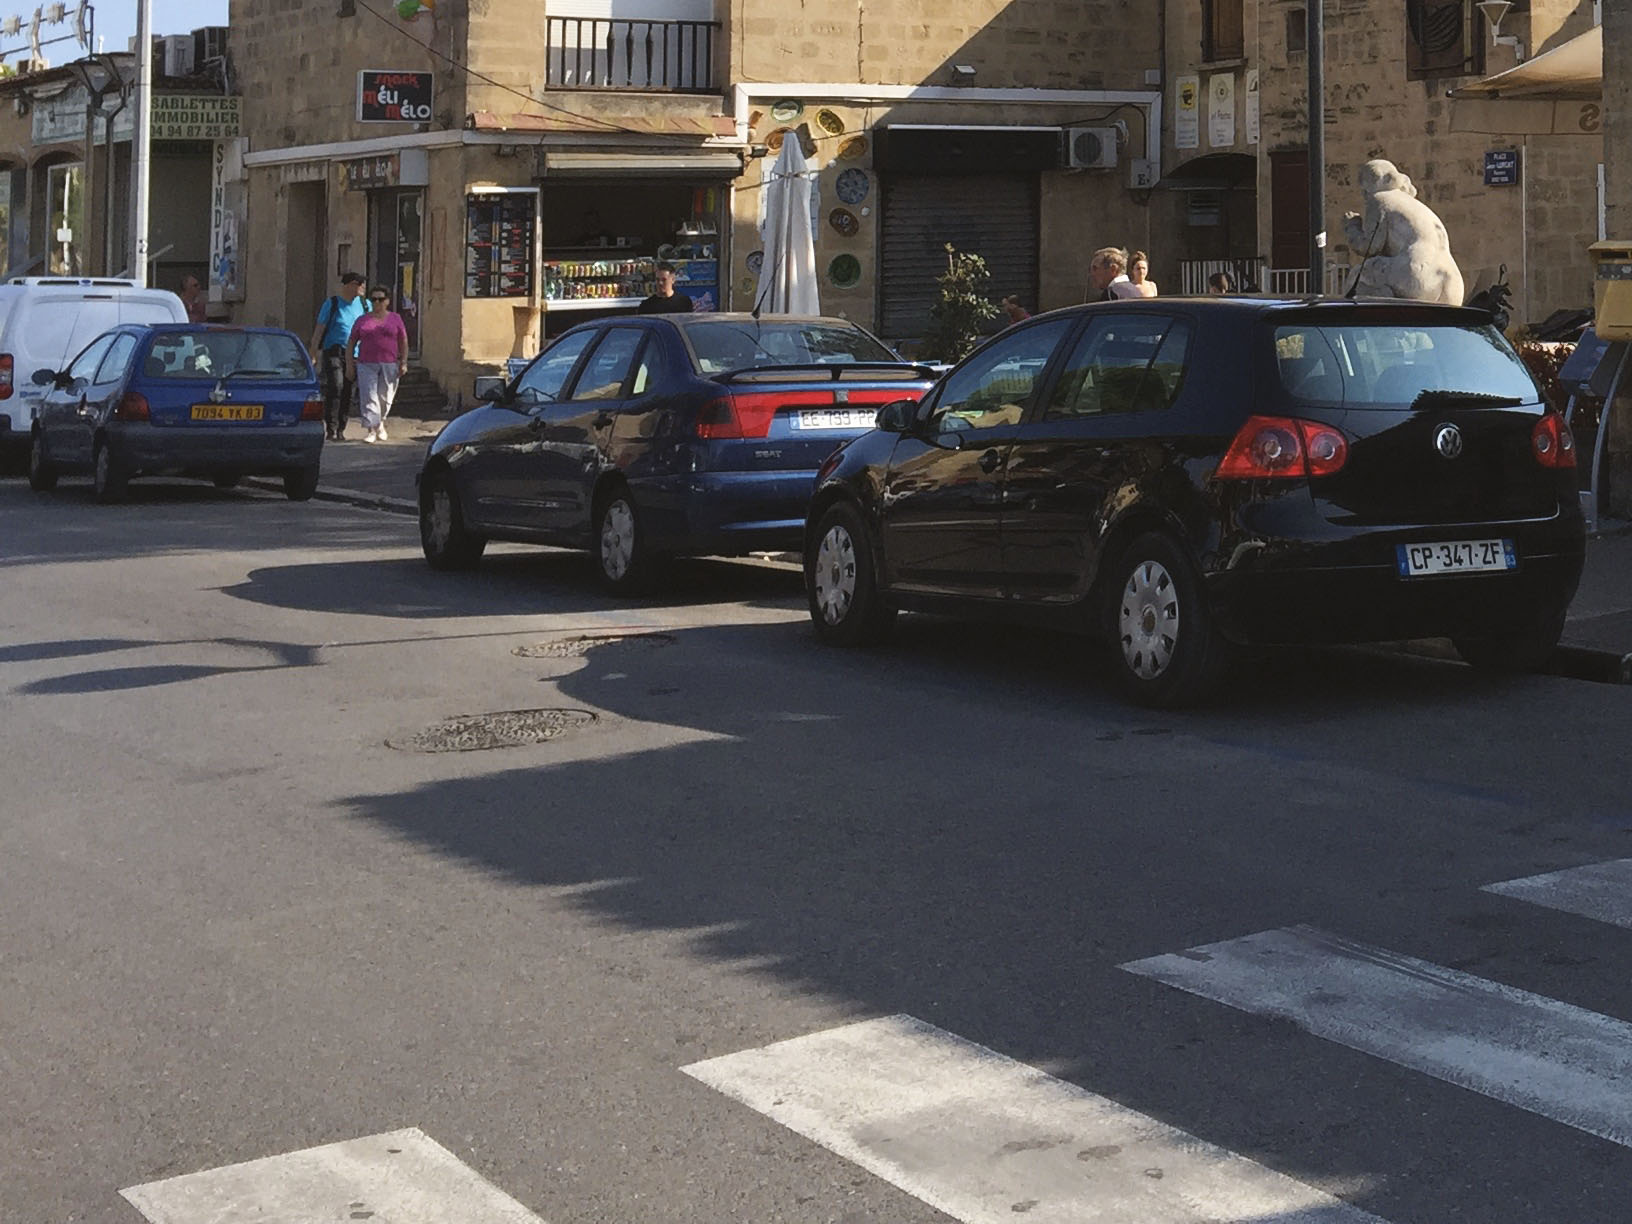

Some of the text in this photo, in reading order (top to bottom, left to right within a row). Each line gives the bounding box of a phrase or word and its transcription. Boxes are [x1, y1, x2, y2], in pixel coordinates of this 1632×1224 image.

[151, 97, 238, 110] SABLETTES
[150, 112, 239, 124] IMMOBILIER
[213, 143, 225, 274] SYNDIC
[755, 450, 782, 458] SEAT
